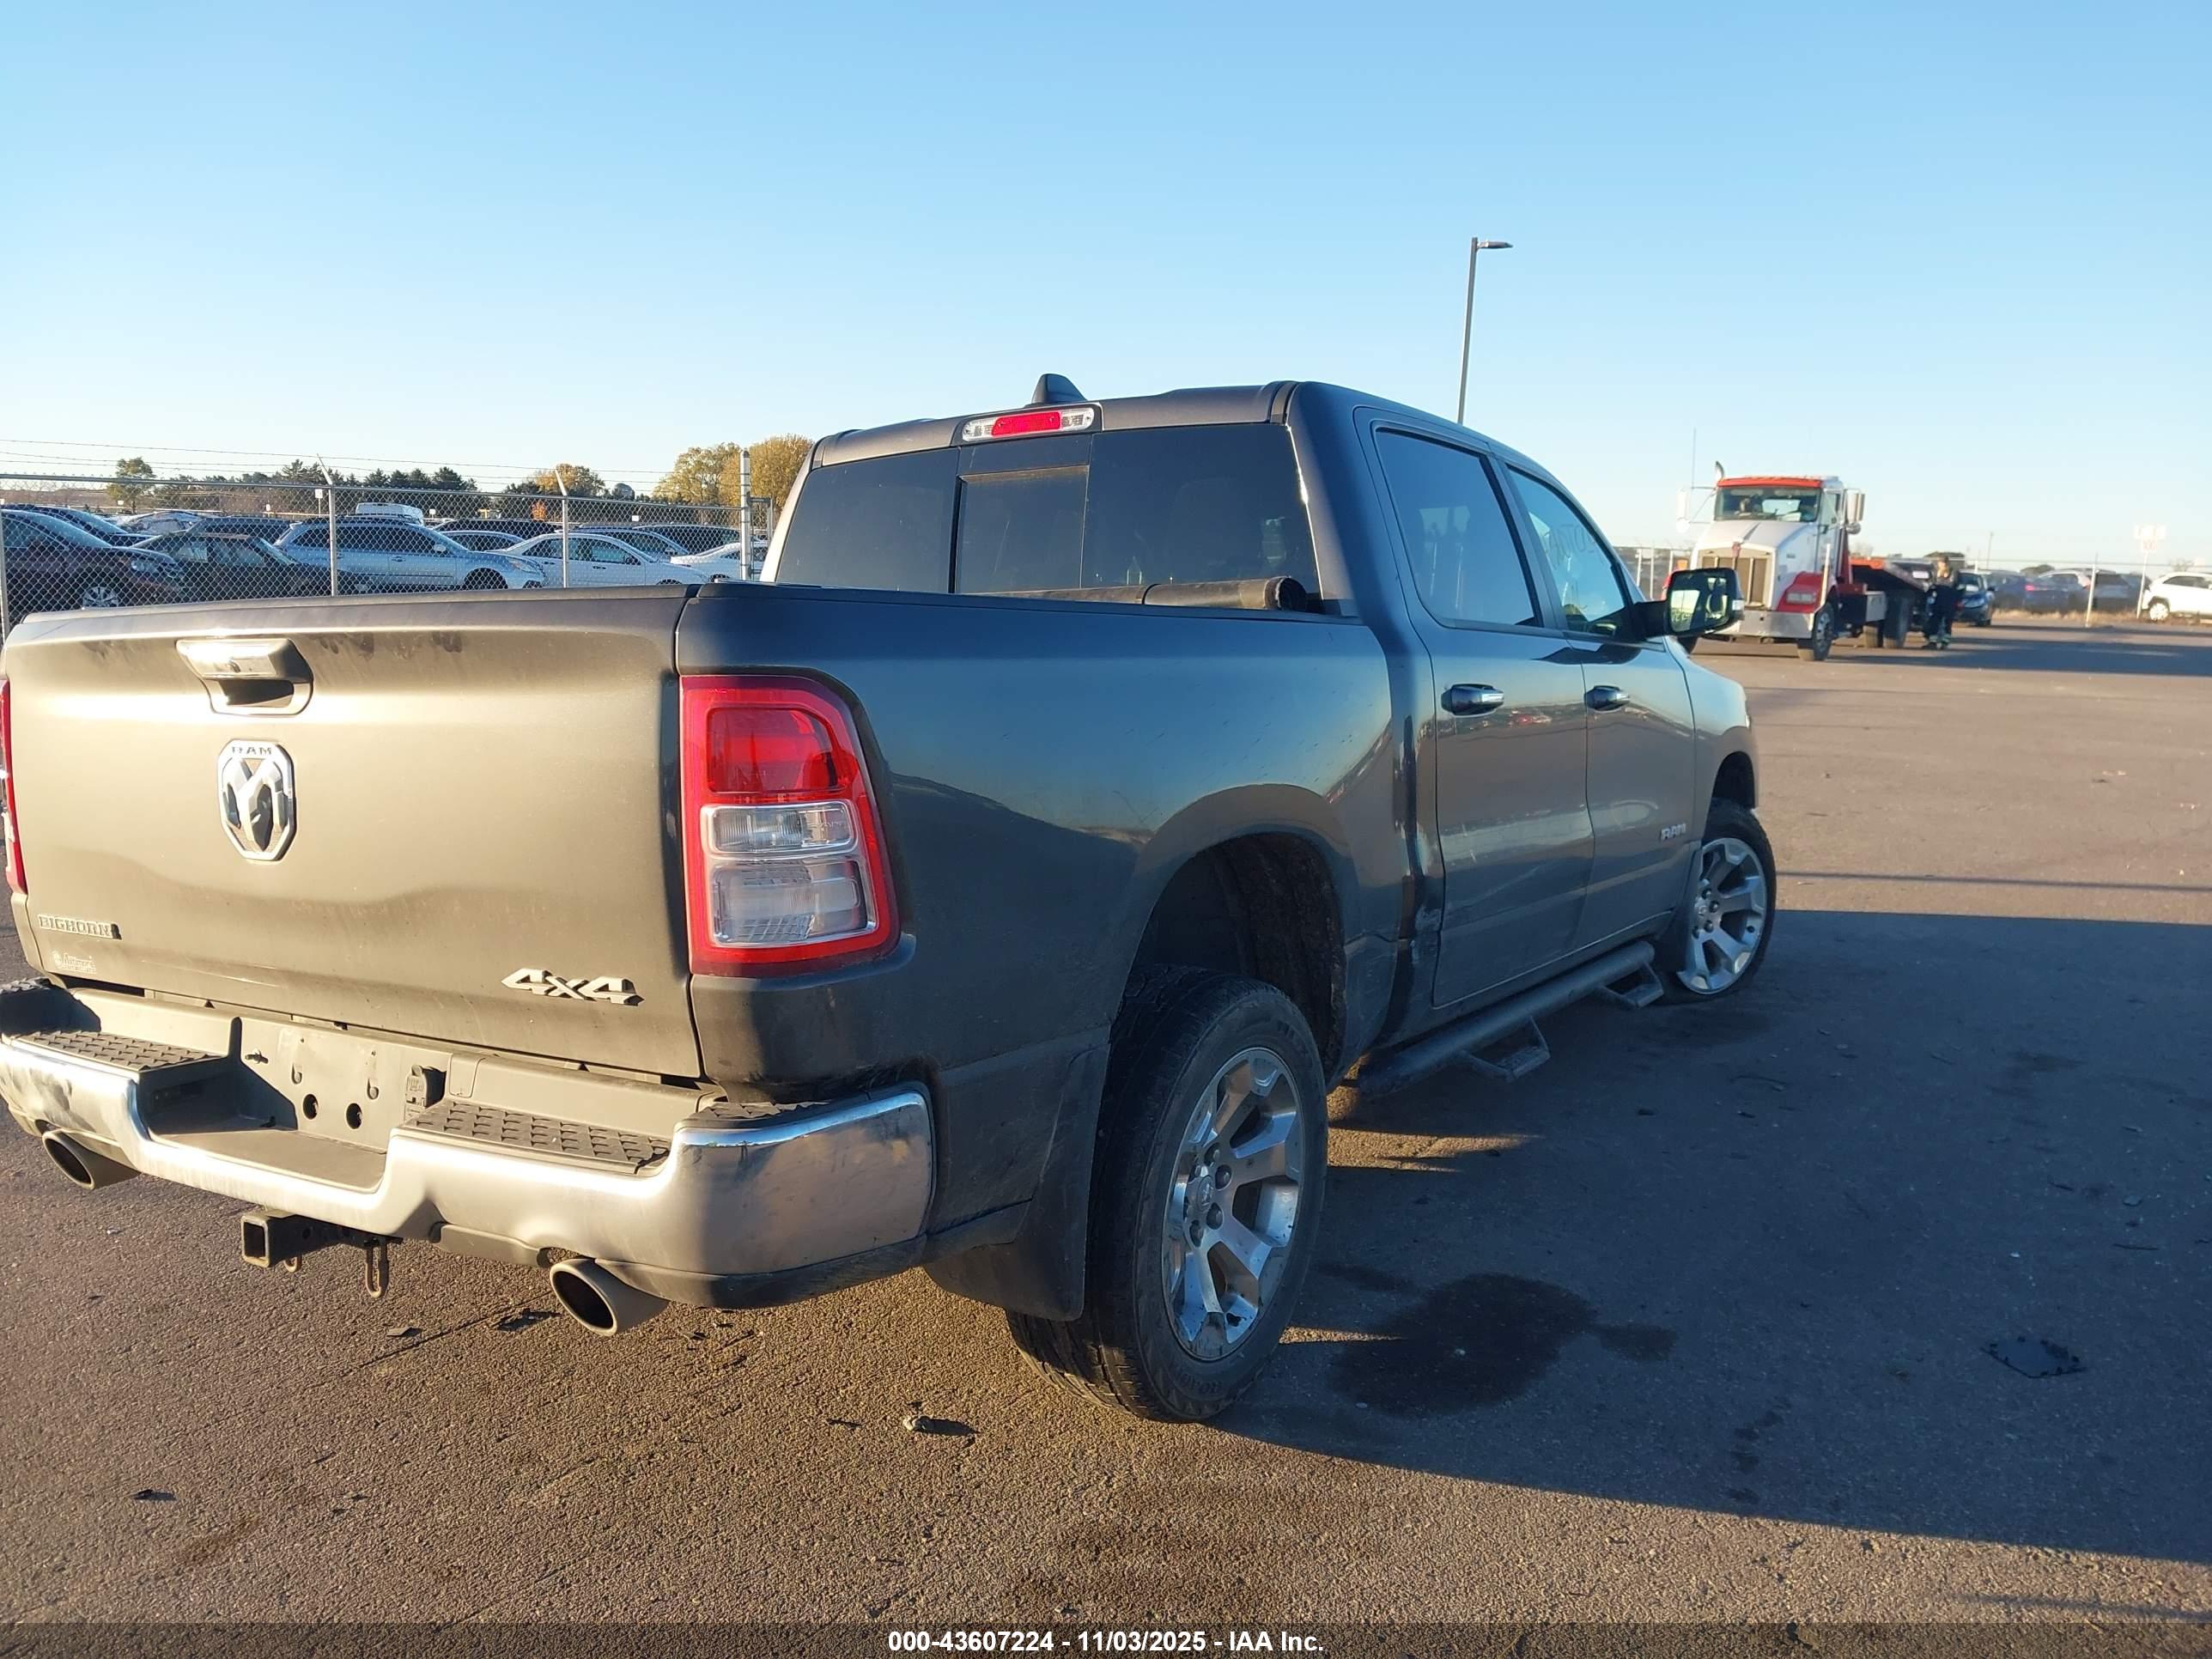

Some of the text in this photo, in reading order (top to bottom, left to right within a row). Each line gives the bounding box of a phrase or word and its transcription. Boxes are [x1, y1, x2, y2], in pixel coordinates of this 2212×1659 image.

[231, 745, 272, 756] RAM
[1660, 823, 1686, 840] RAM
[38, 915, 119, 939] BIGHORN
